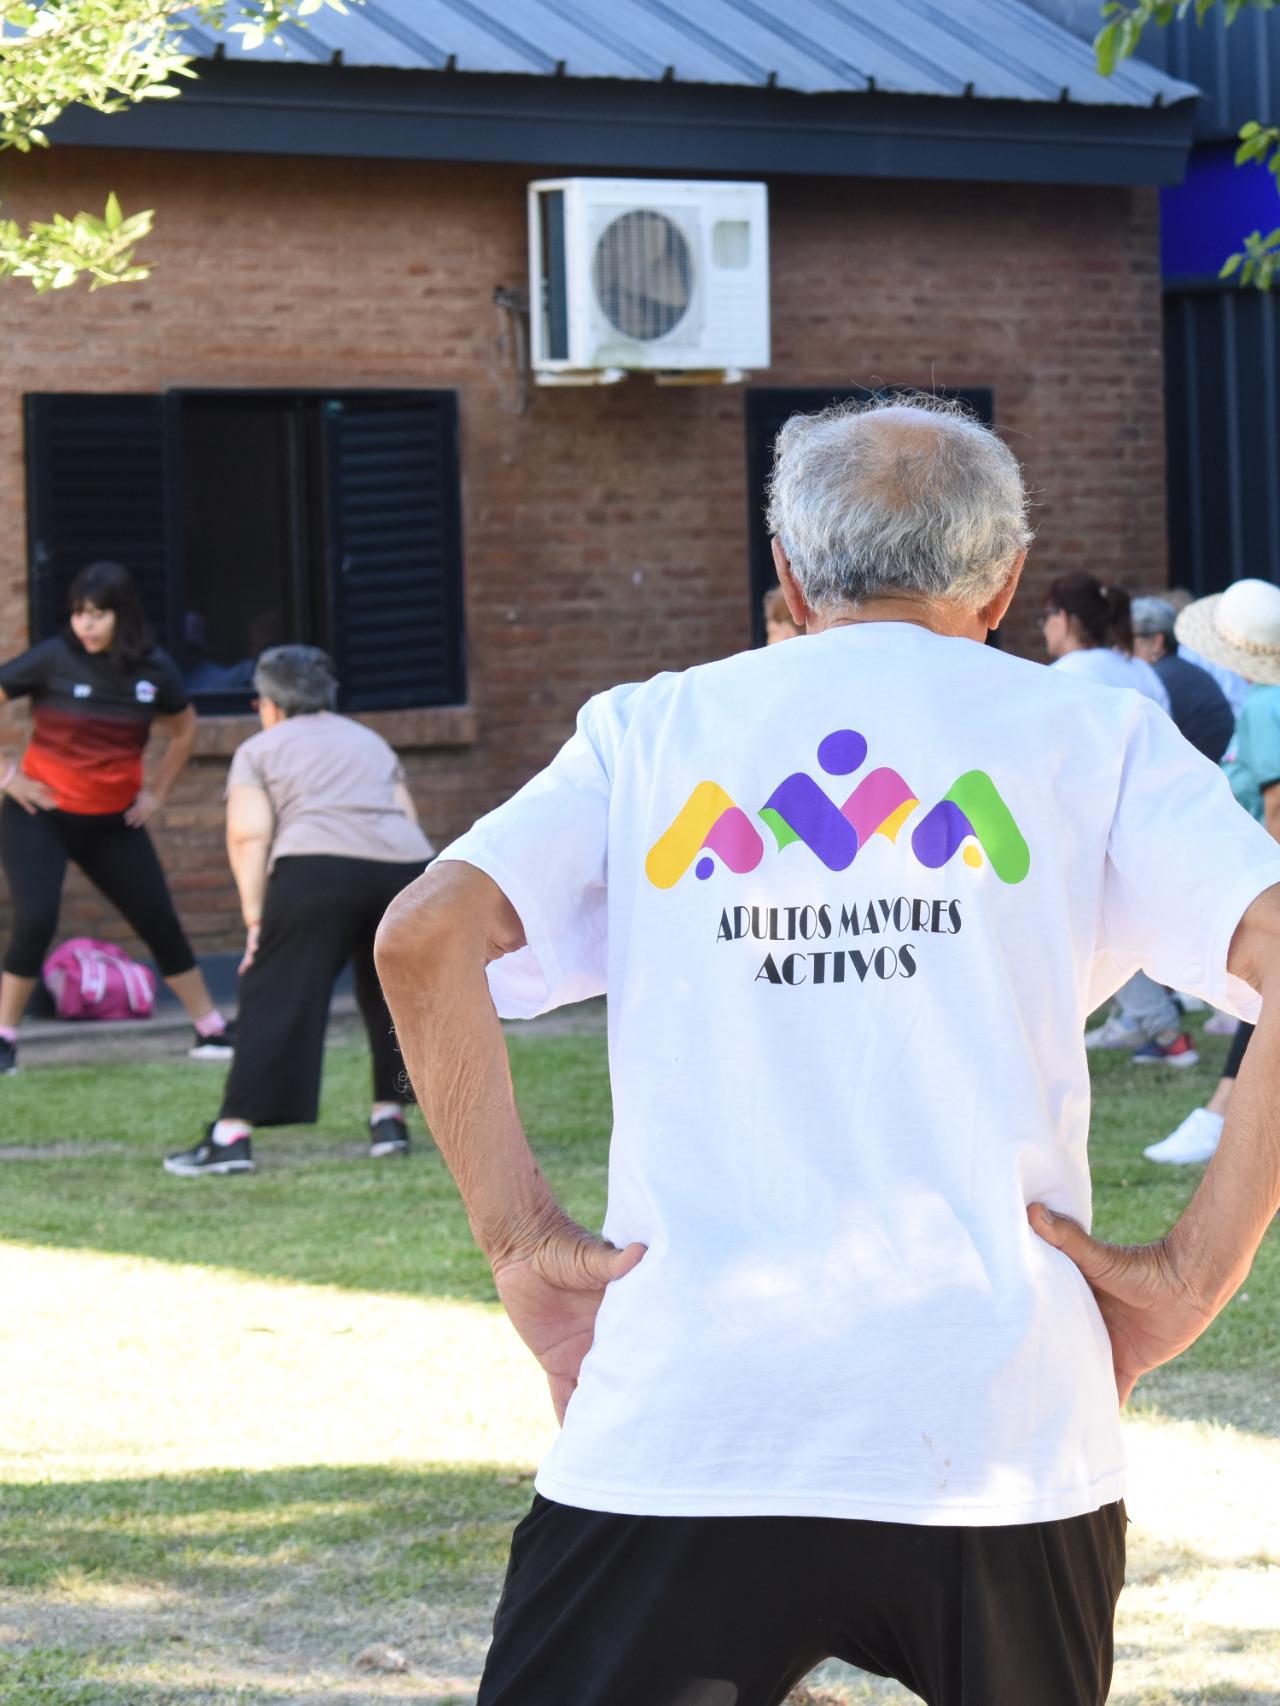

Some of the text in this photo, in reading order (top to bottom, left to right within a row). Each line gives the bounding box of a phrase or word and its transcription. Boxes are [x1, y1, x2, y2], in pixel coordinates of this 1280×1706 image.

[717, 896, 962, 942] ADULTOS MAYORES
[754, 943, 917, 986] ACTIVOS
